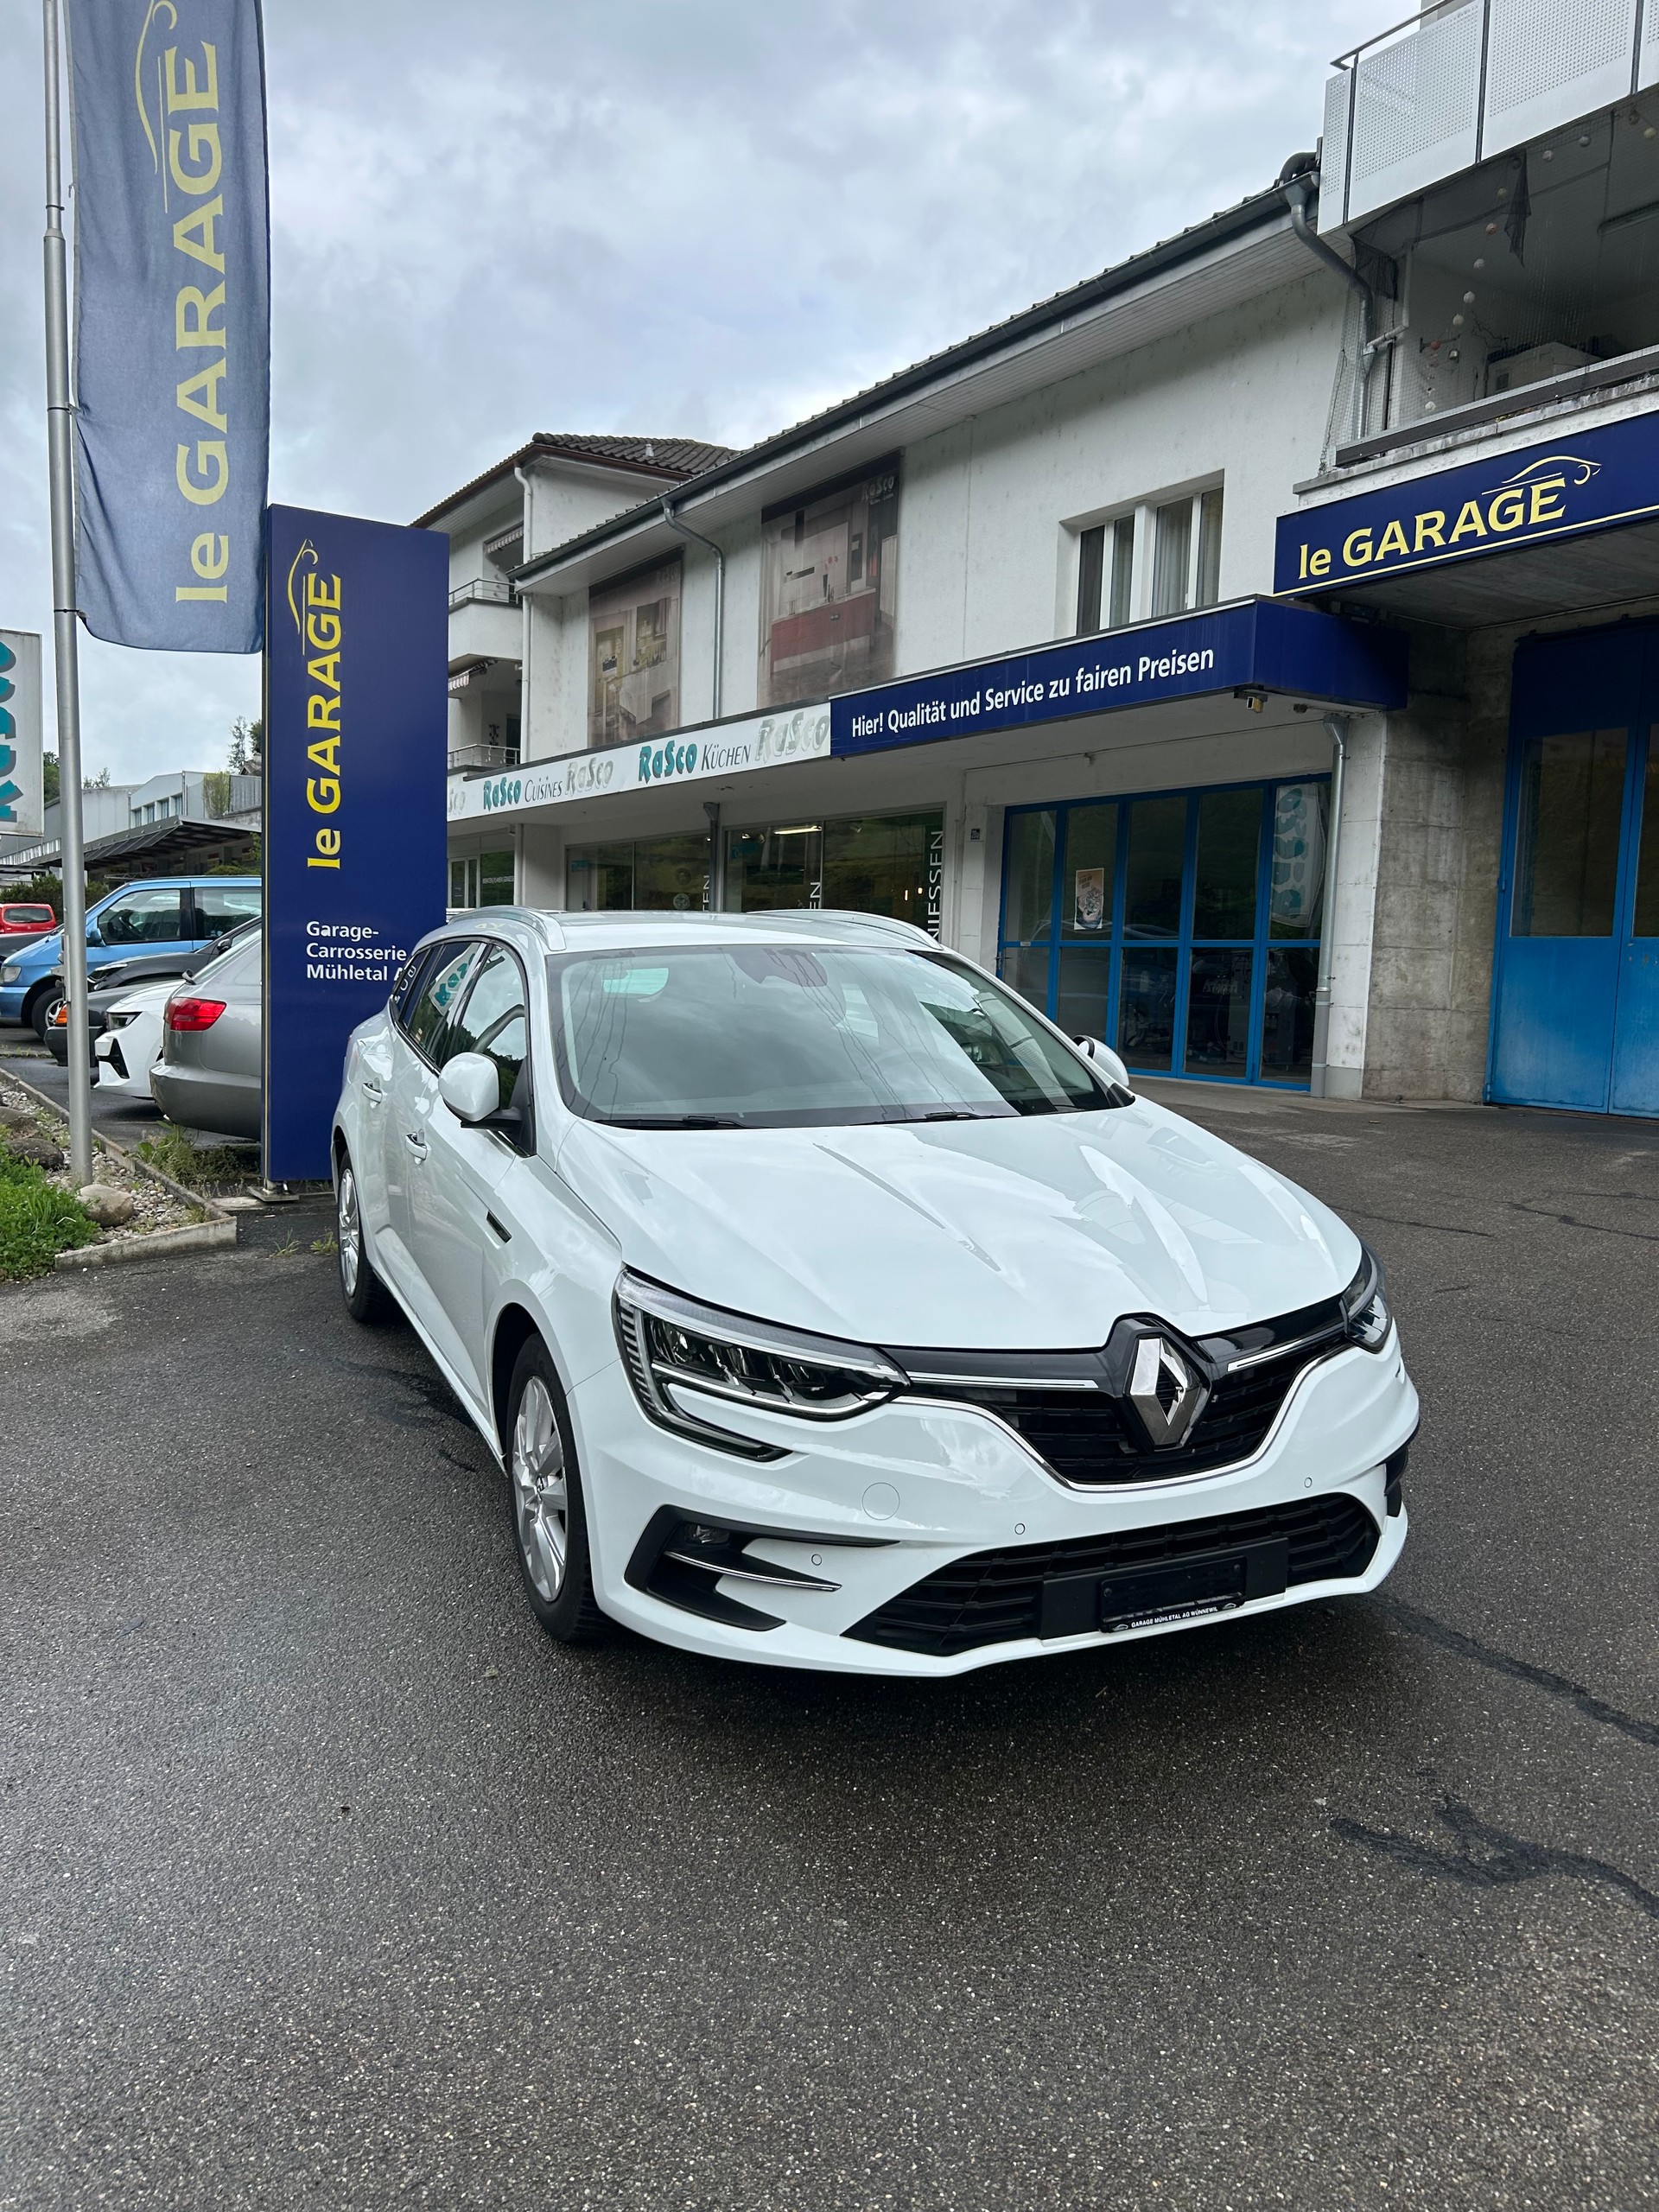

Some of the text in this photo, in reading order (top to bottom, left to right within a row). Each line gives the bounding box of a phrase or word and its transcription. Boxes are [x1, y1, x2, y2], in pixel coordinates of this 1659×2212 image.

[165, 41, 229, 604] le GARAGE
[1299, 477, 1566, 579] le GARAGE
[852, 648, 1214, 738] Hier! Qualität und Service zu fairen Preisen
[305, 572, 342, 869] le GARAGE
[638, 740, 698, 785] RaSco
[306, 921, 379, 942] Garage-
[306, 942, 407, 961] Carrosserie
[307, 963, 388, 981] Mühletal
[1131, 1618, 1154, 1628] GARAGE
[1154, 1613, 1181, 1624] MÜHLETAL
